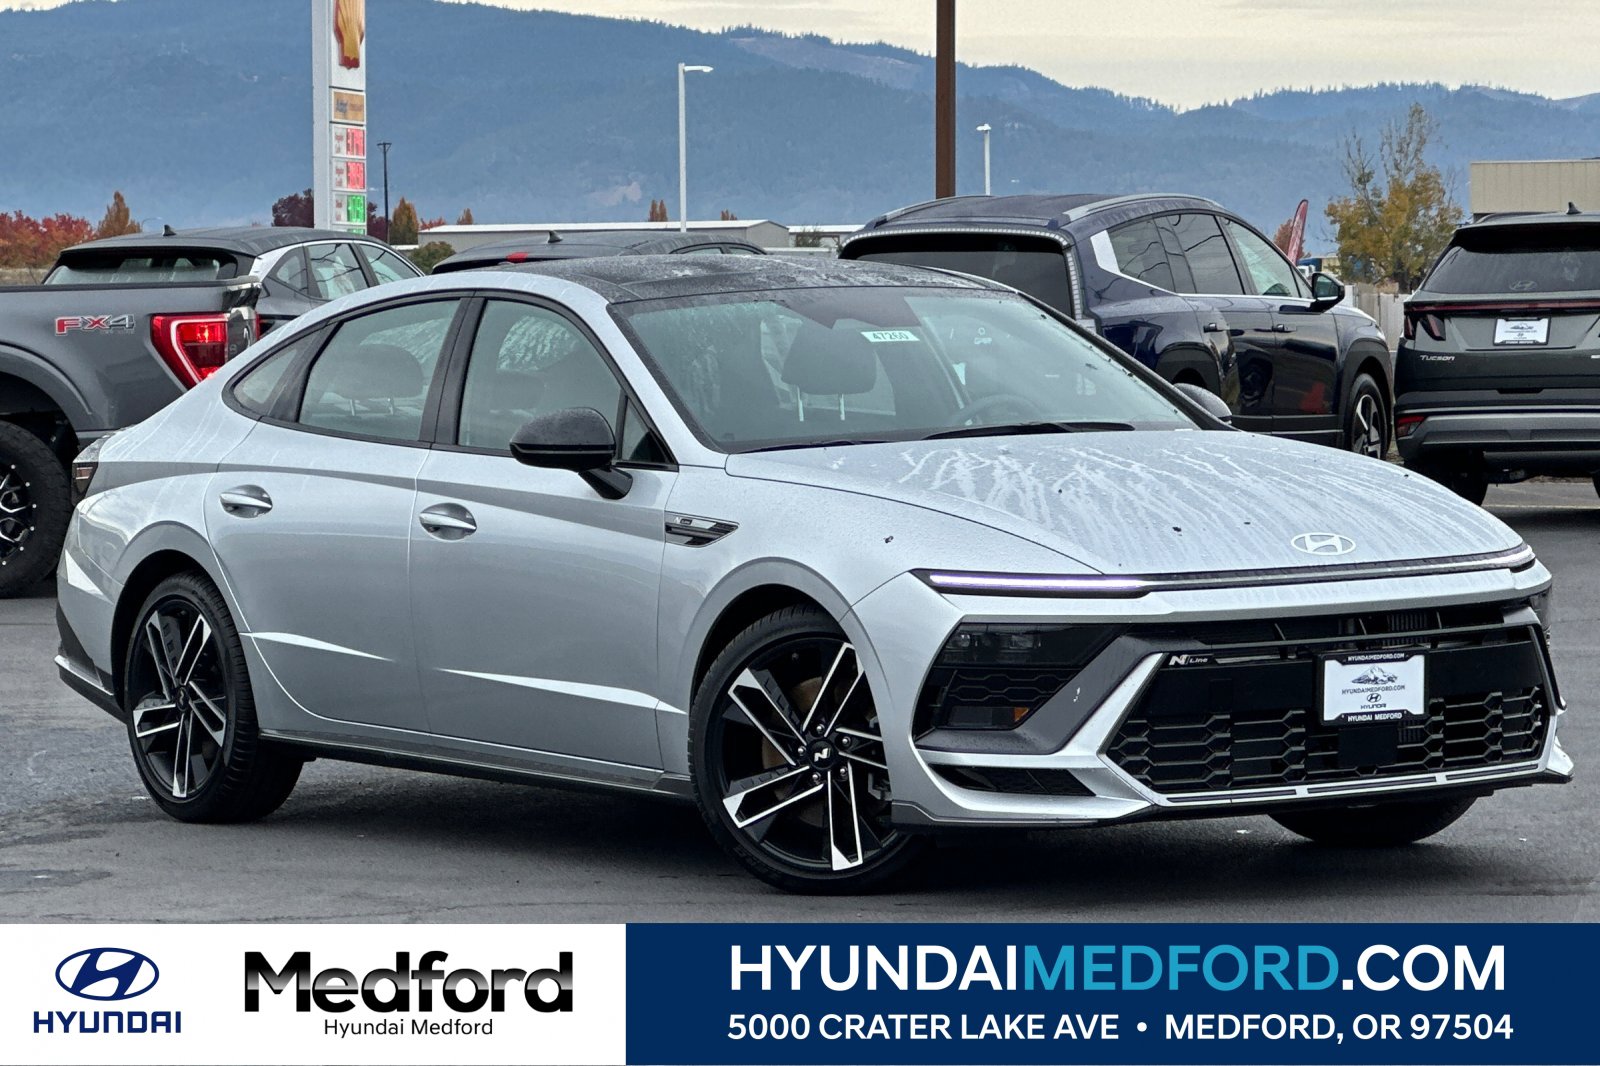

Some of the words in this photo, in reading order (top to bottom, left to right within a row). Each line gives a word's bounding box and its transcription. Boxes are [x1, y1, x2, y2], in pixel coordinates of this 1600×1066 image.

[55, 314, 135, 335] FX4
[872, 332, 910, 341] 47260
[1347, 652, 1405, 662] HYUNDAIMEDFORD.COM
[1341, 684, 1406, 695] HYUNDAIMEDFORD.COM
[1347, 714, 1373, 722] HYUNDAI
[1374, 712, 1403, 721] MEDFORD
